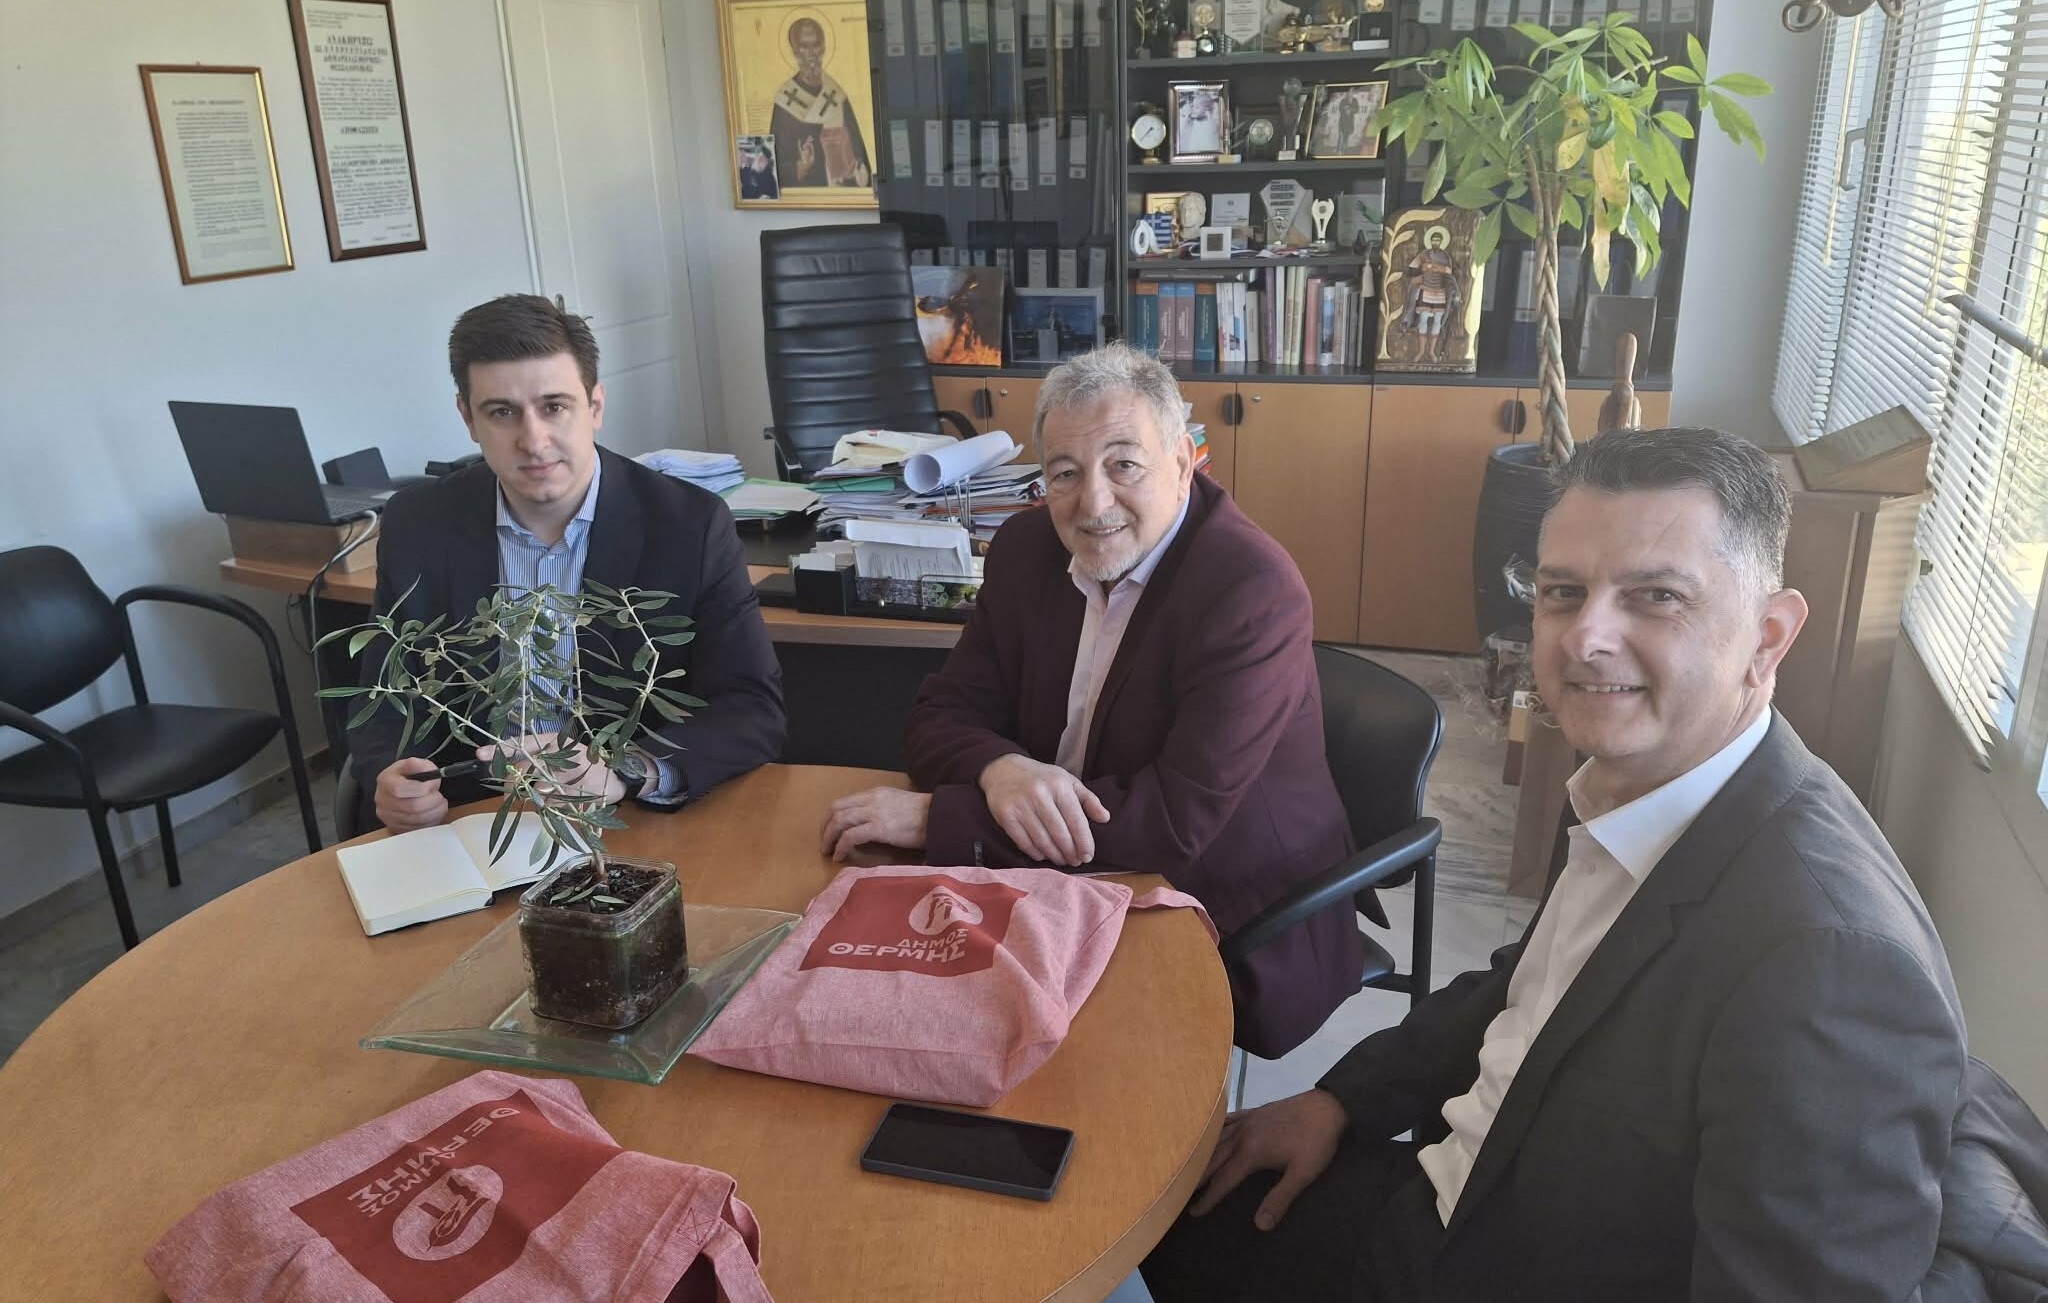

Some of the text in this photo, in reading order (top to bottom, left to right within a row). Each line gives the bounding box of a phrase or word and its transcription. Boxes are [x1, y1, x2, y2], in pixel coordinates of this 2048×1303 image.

[828, 940, 967, 962] ΘΕΡΜΗΣ
[897, 928, 968, 949] ΔΗΜΟΣ
[347, 1107, 521, 1201] ΘΕΡΜΗΣ
[357, 1151, 456, 1218] ΔΗΜΟΣ
